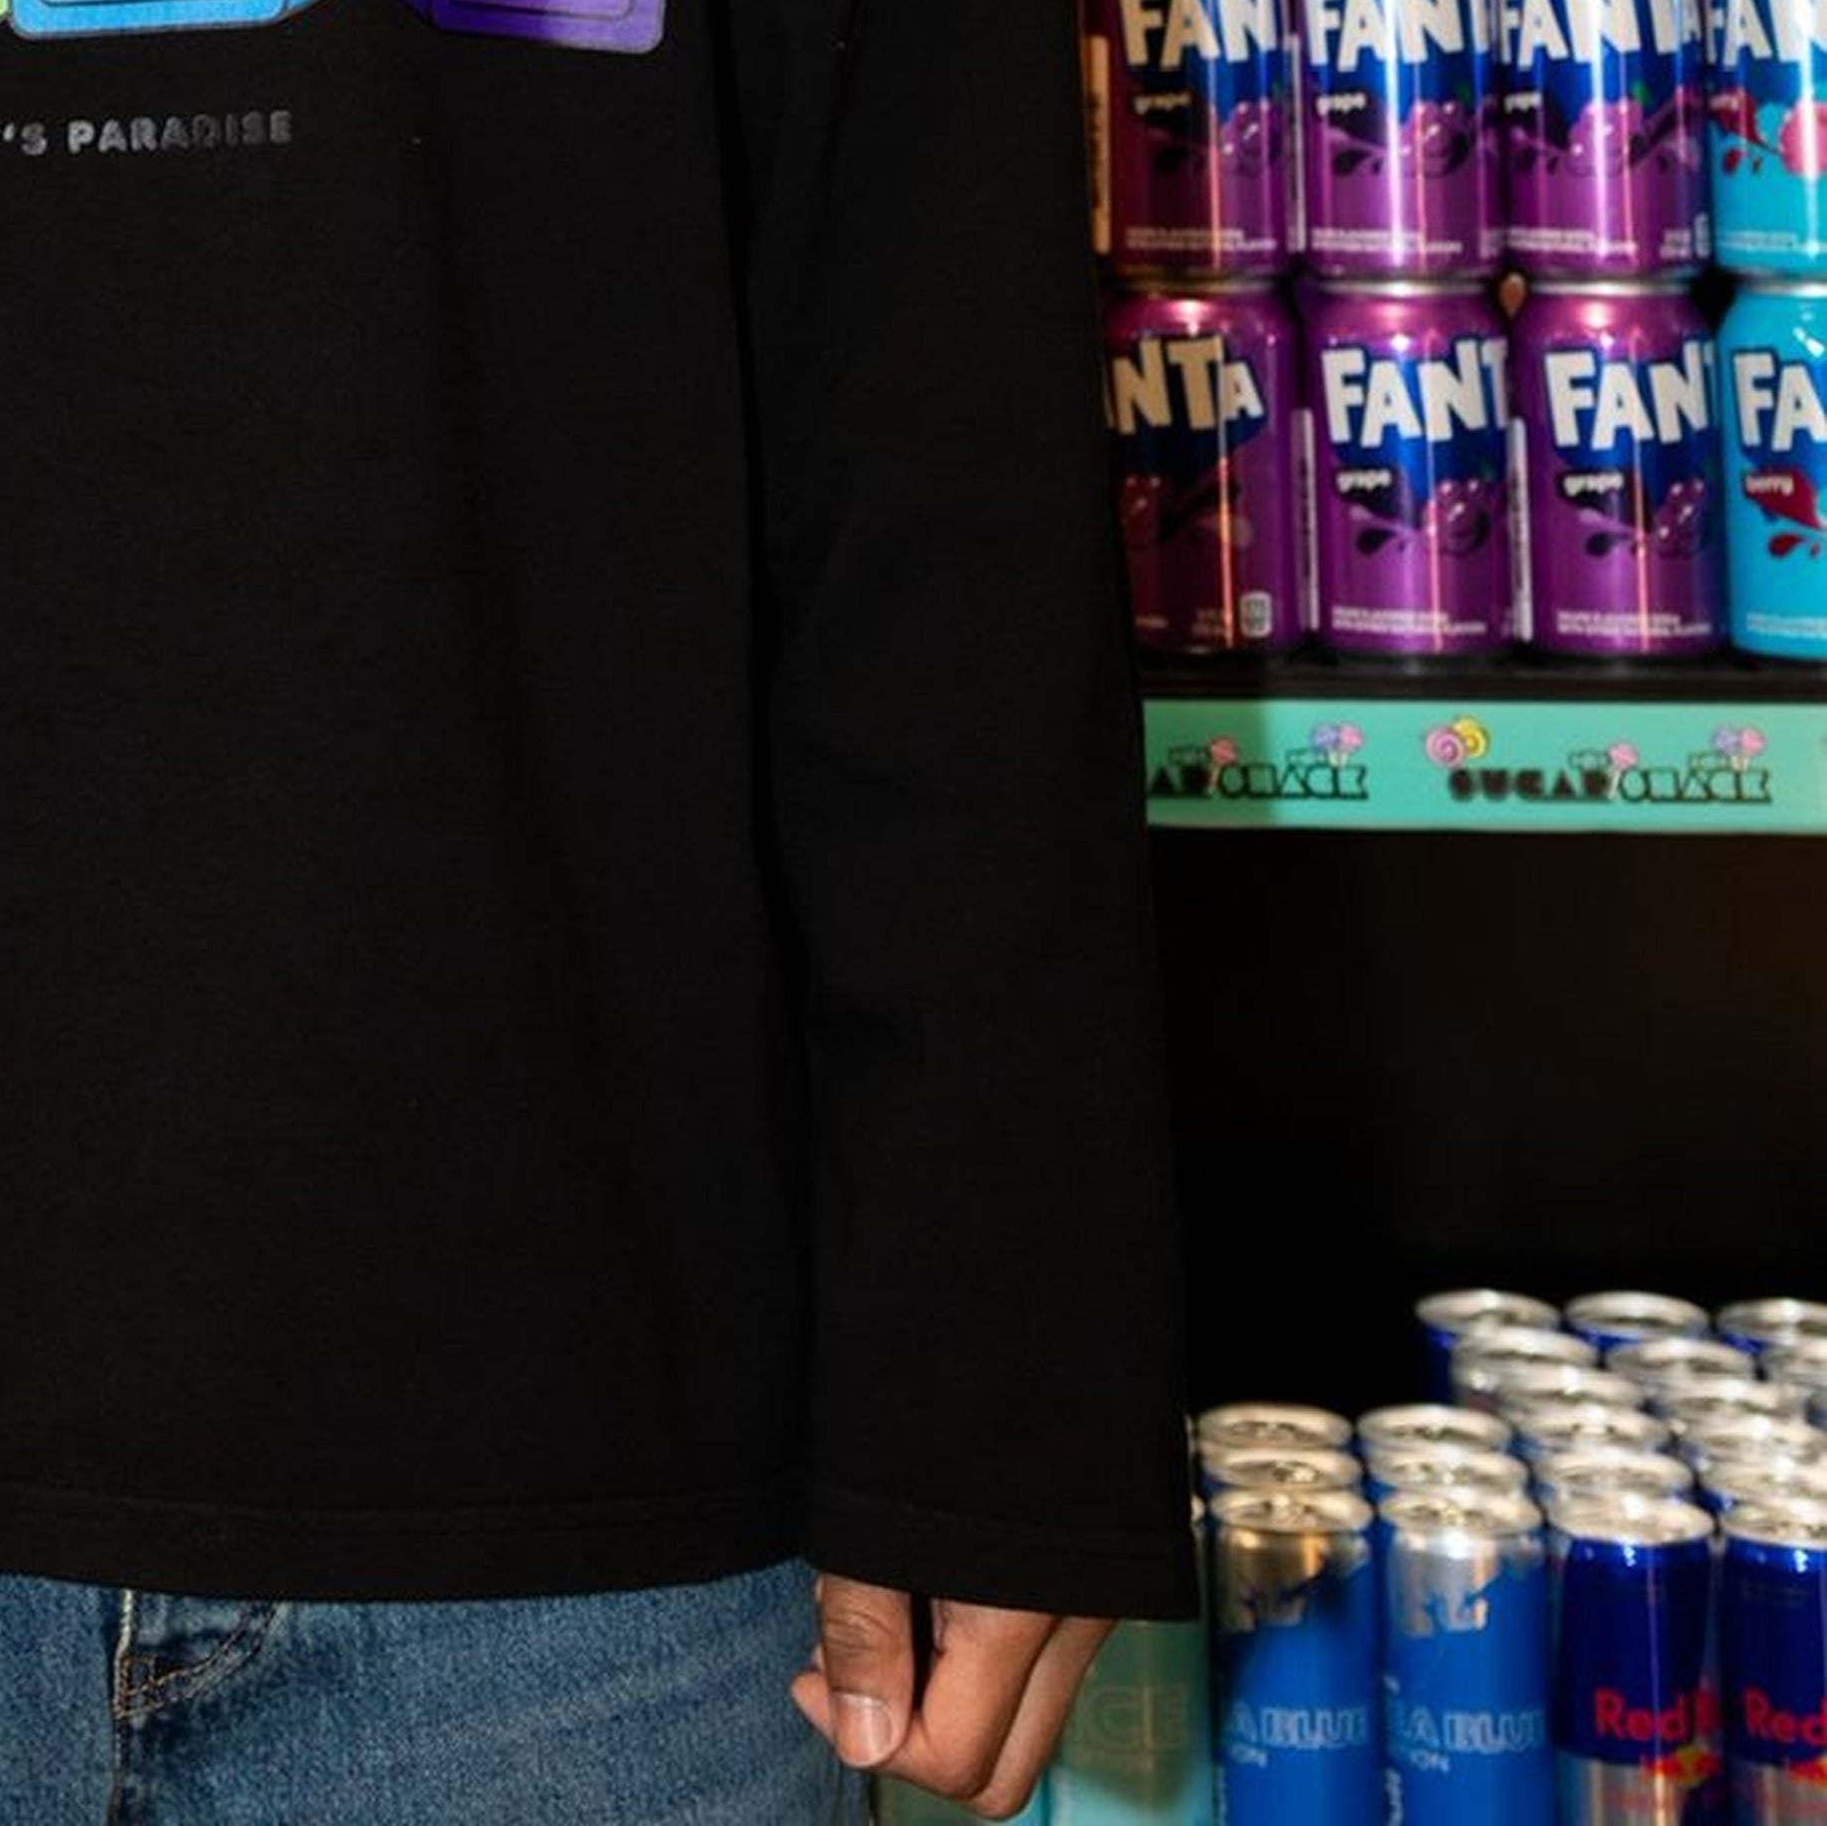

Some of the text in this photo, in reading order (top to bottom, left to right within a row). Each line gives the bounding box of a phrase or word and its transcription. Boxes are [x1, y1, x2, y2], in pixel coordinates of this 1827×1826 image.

[67, 110, 293, 153] PARADISE
[1102, 335, 1264, 436] NTA
[1322, 338, 1507, 447] FANT
[1545, 340, 1714, 451] FAN
[1448, 768, 1611, 803] SUGAR
[1595, 1688, 1687, 1742] Red
